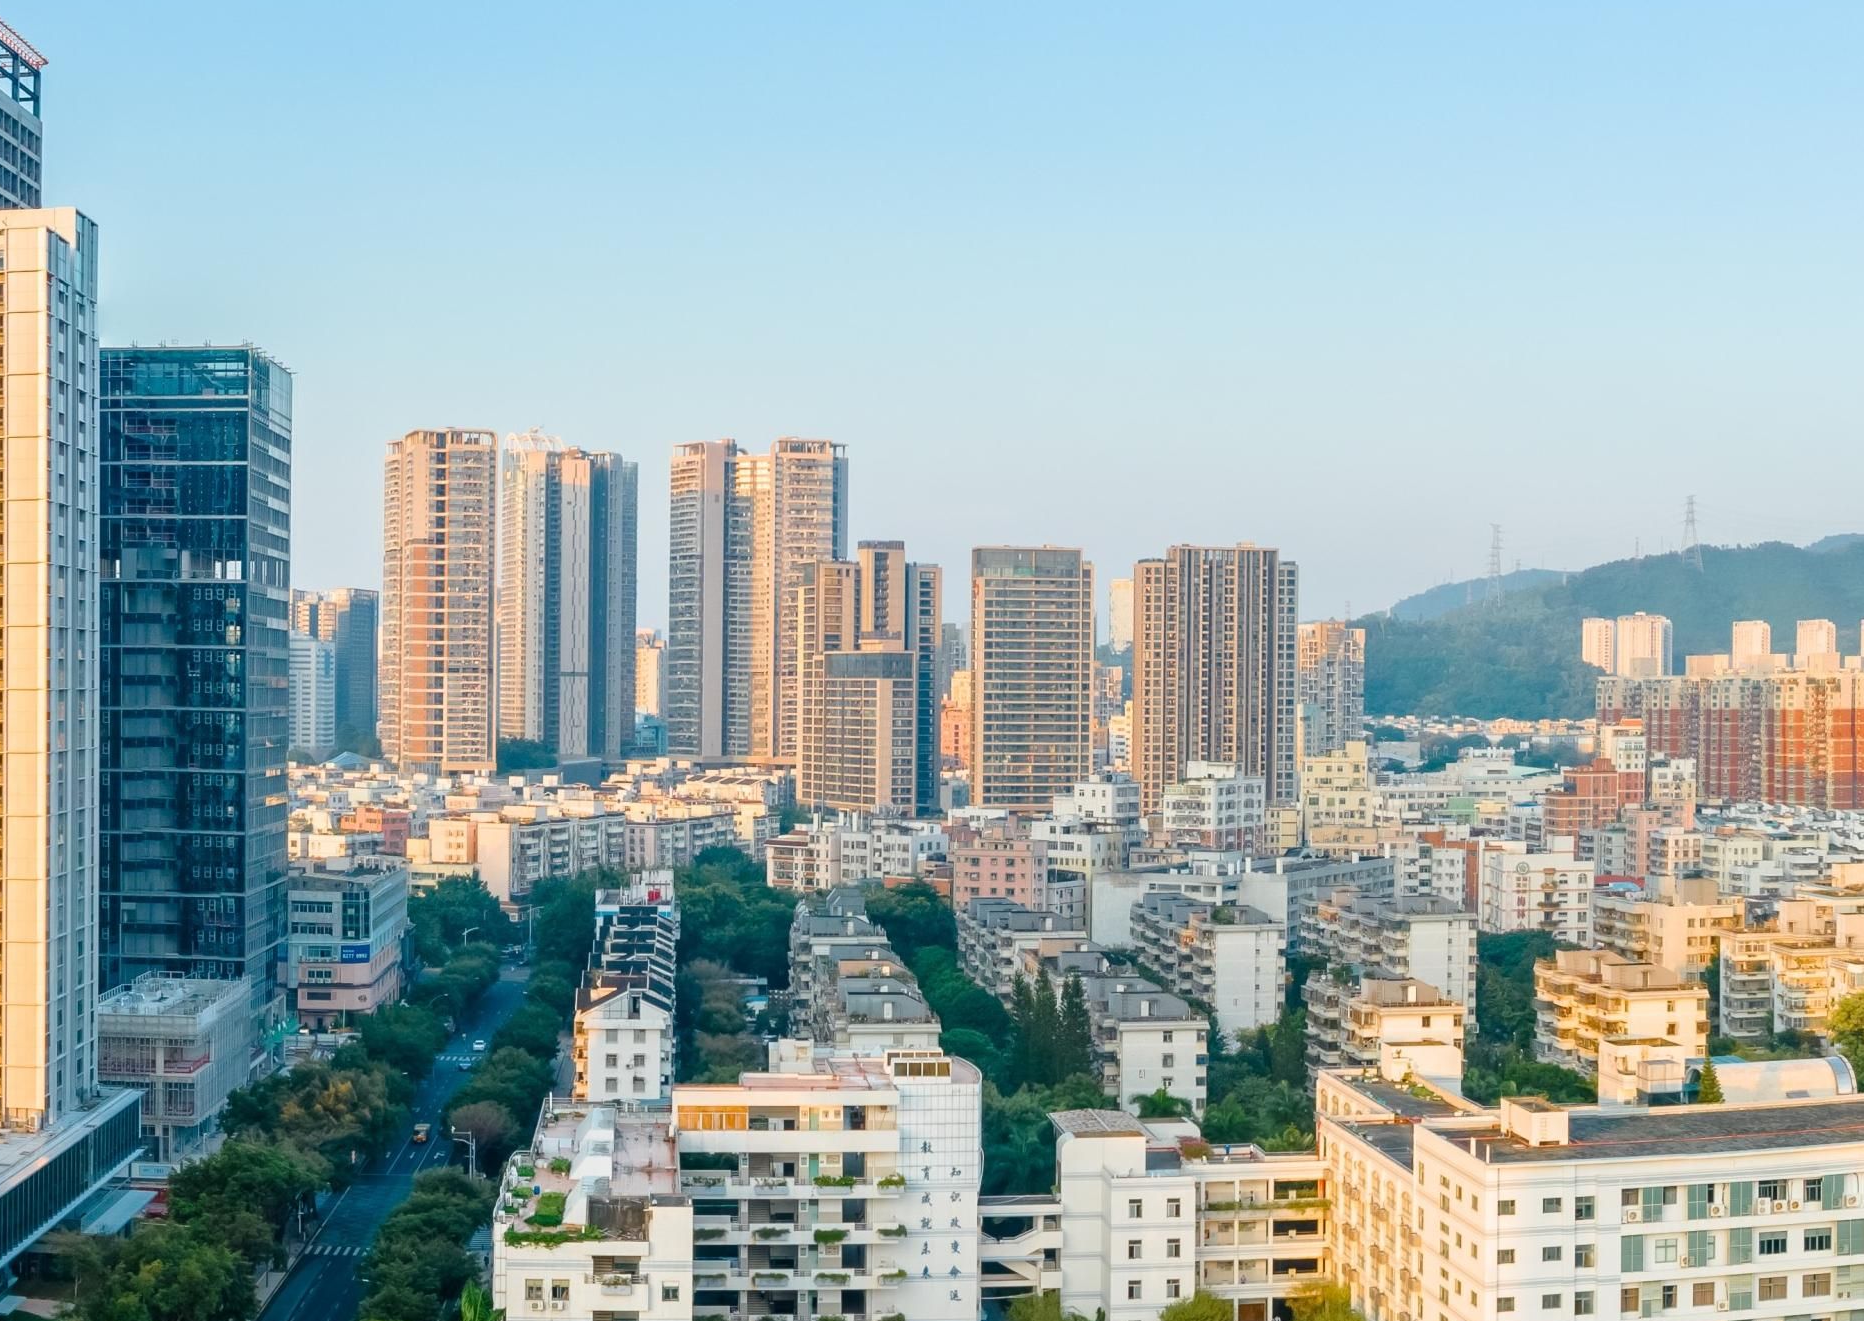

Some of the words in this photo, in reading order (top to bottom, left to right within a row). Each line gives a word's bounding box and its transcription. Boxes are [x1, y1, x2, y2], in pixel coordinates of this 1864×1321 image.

[949, 1166, 962, 1302] 知识改变命运
